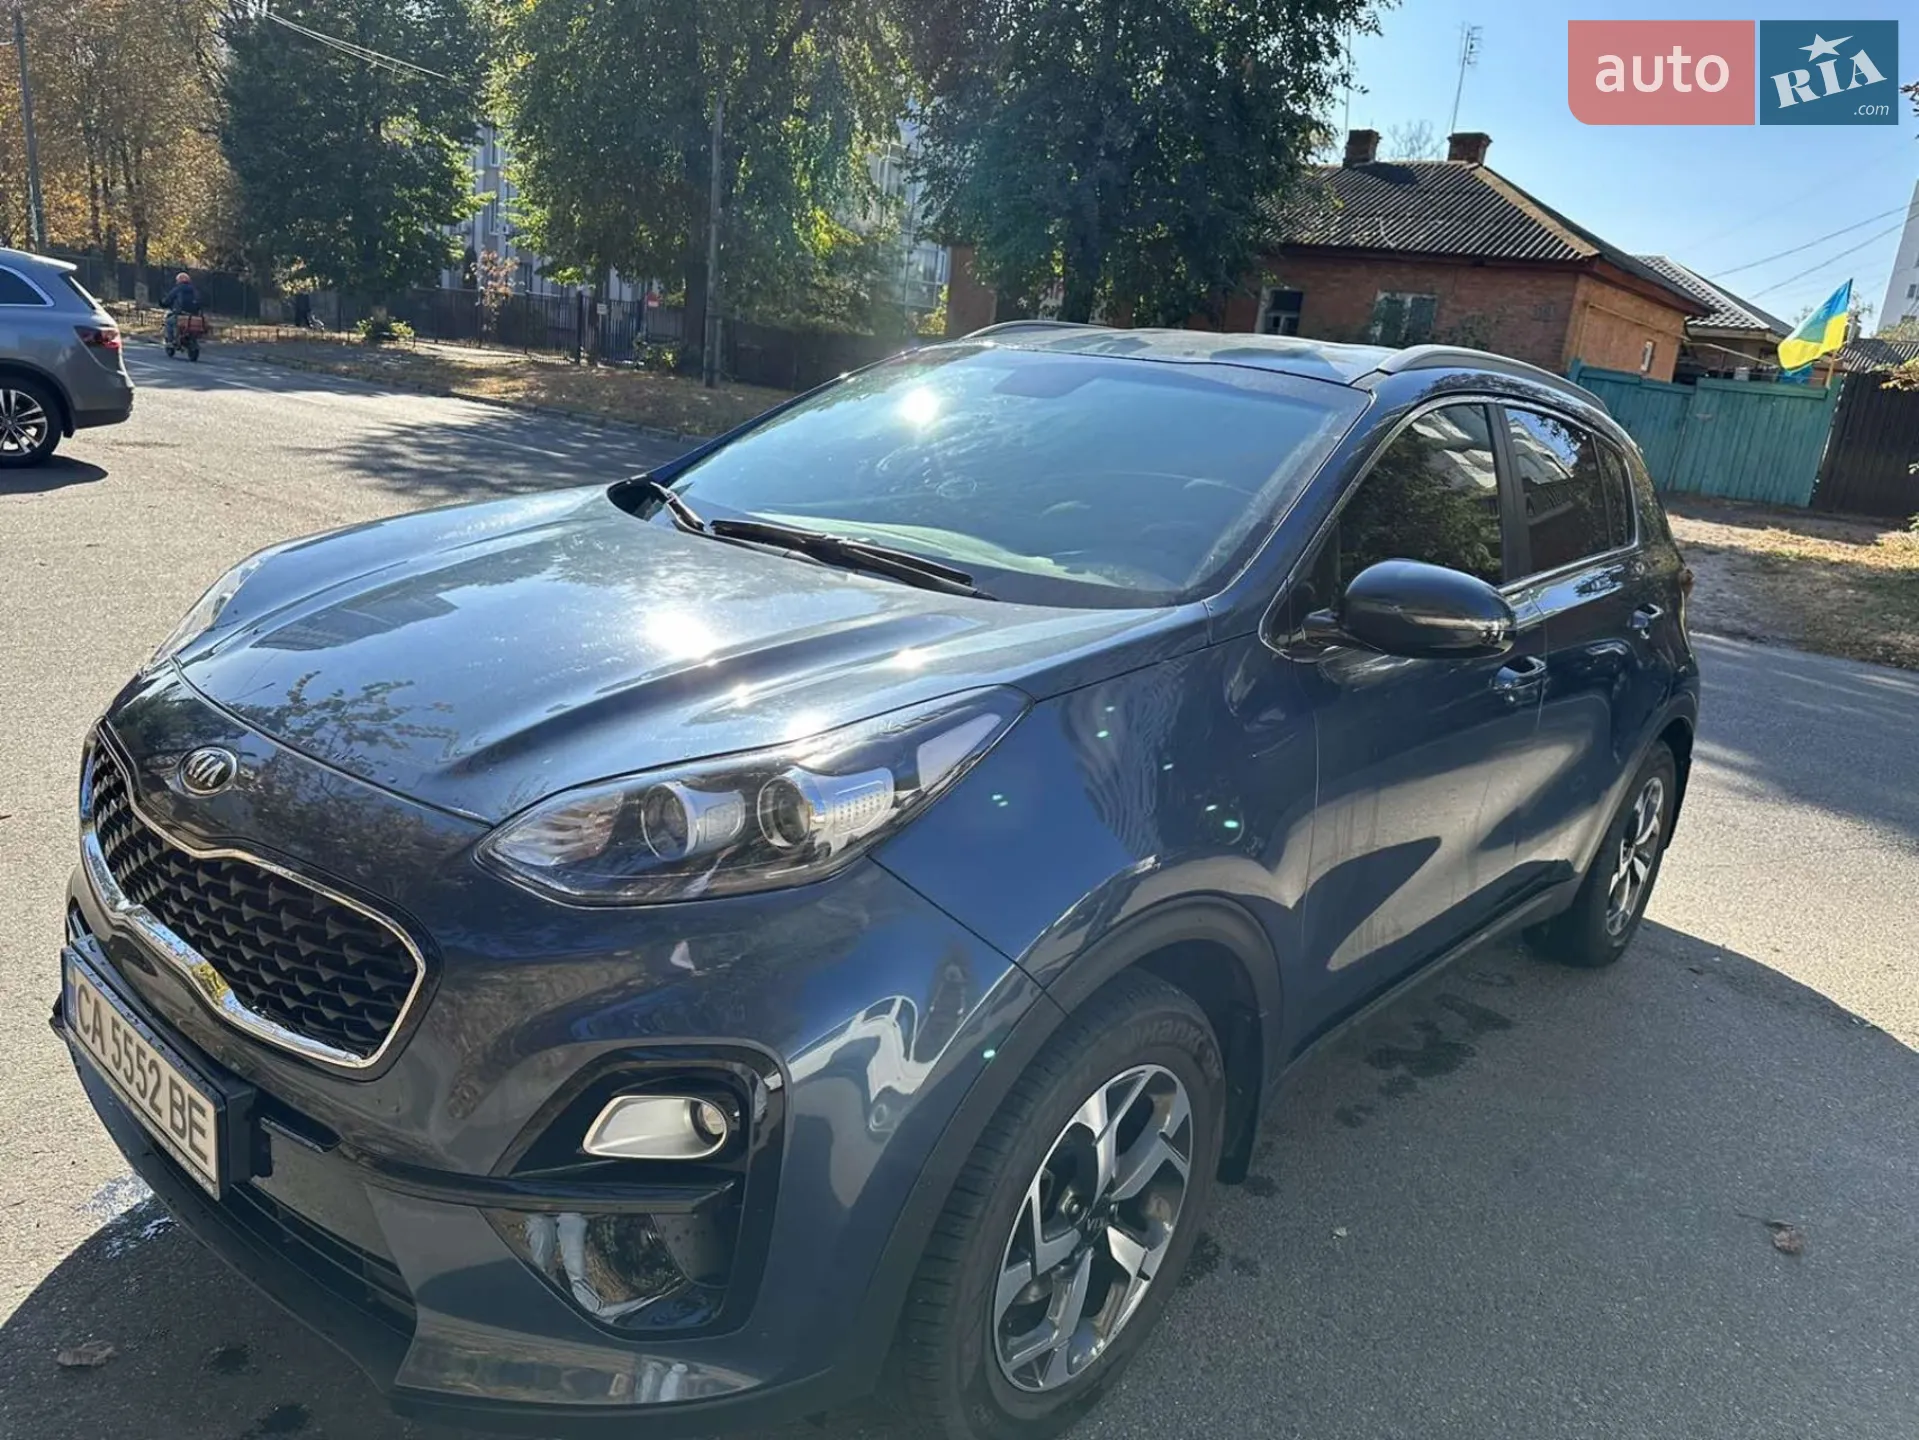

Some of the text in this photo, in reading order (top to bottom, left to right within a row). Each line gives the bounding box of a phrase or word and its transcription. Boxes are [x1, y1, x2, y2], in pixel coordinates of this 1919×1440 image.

[78, 984, 209, 1166] CA 5552 BE
